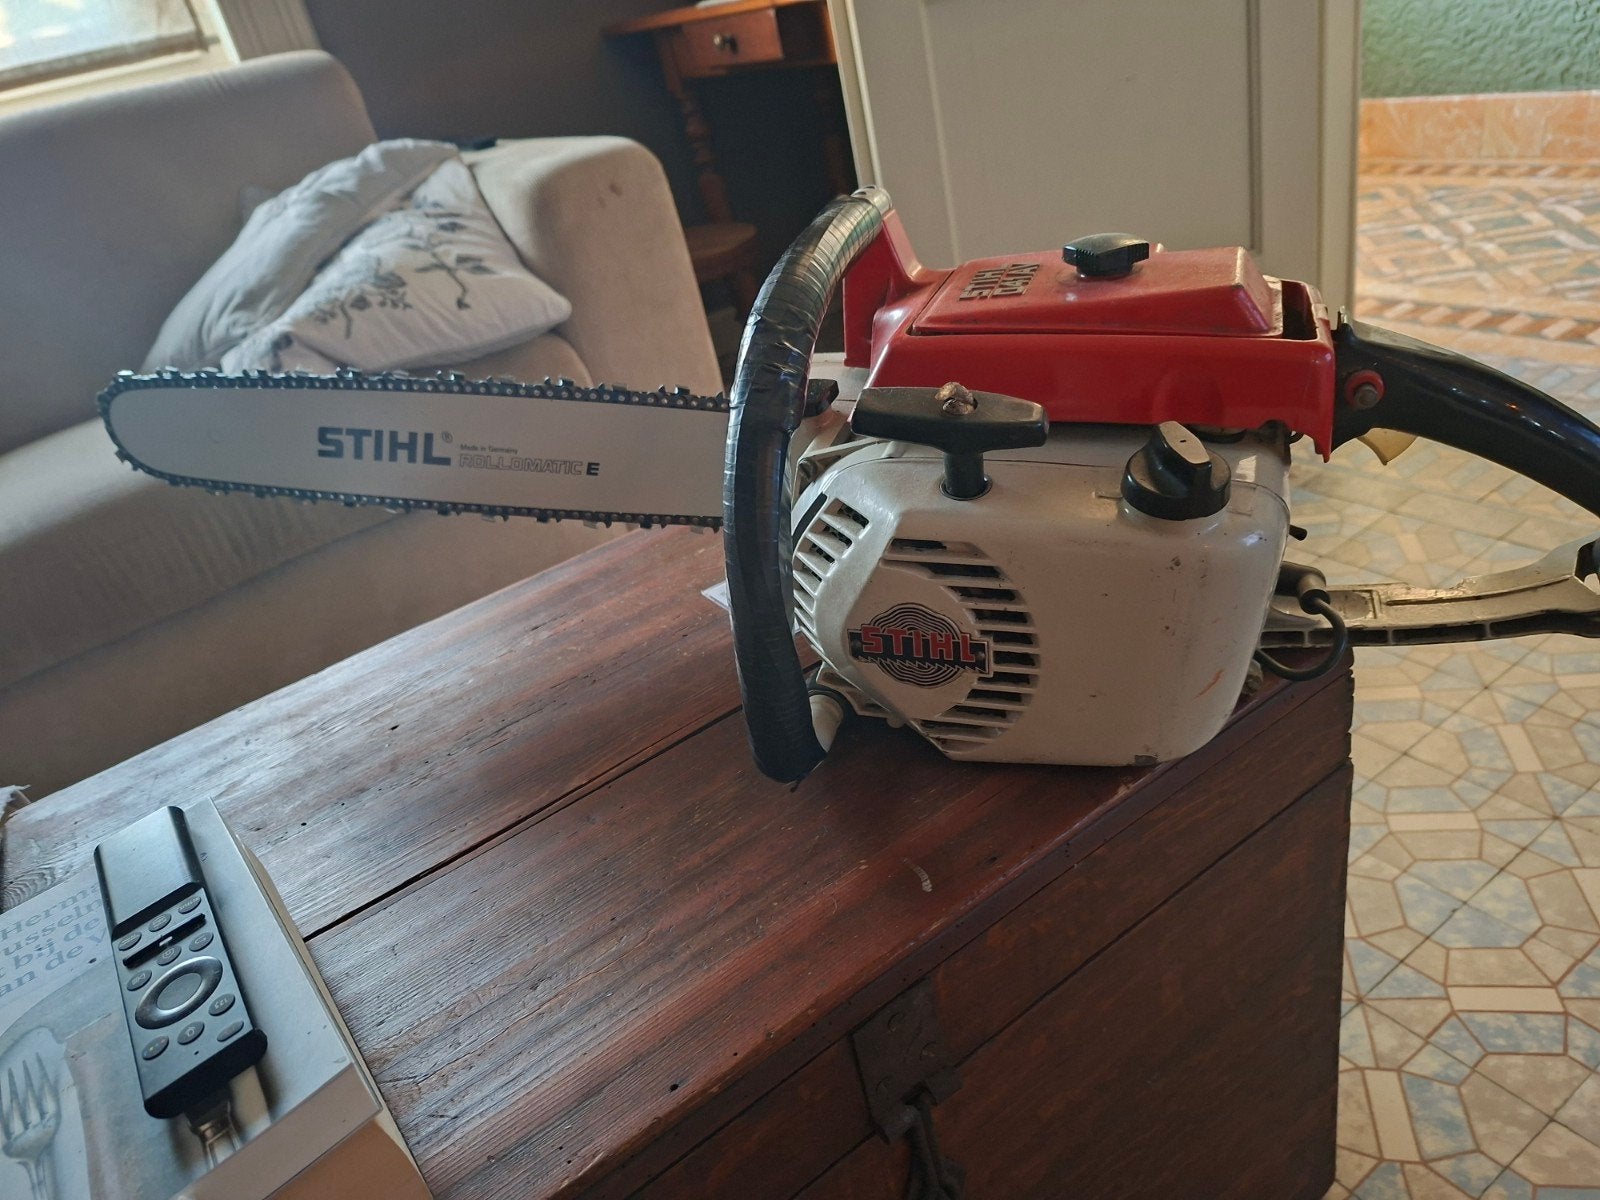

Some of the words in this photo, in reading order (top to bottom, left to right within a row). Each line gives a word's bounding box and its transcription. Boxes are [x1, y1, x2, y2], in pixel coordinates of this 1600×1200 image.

[959, 264, 1011, 301] STIHL
[318, 426, 451, 466] STIHL
[459, 453, 583, 476] ROLLOMATIC
[586, 462, 600, 477] E
[861, 624, 976, 663] STIHL
[63, 917, 100, 942] de
[45, 945, 83, 971] de
